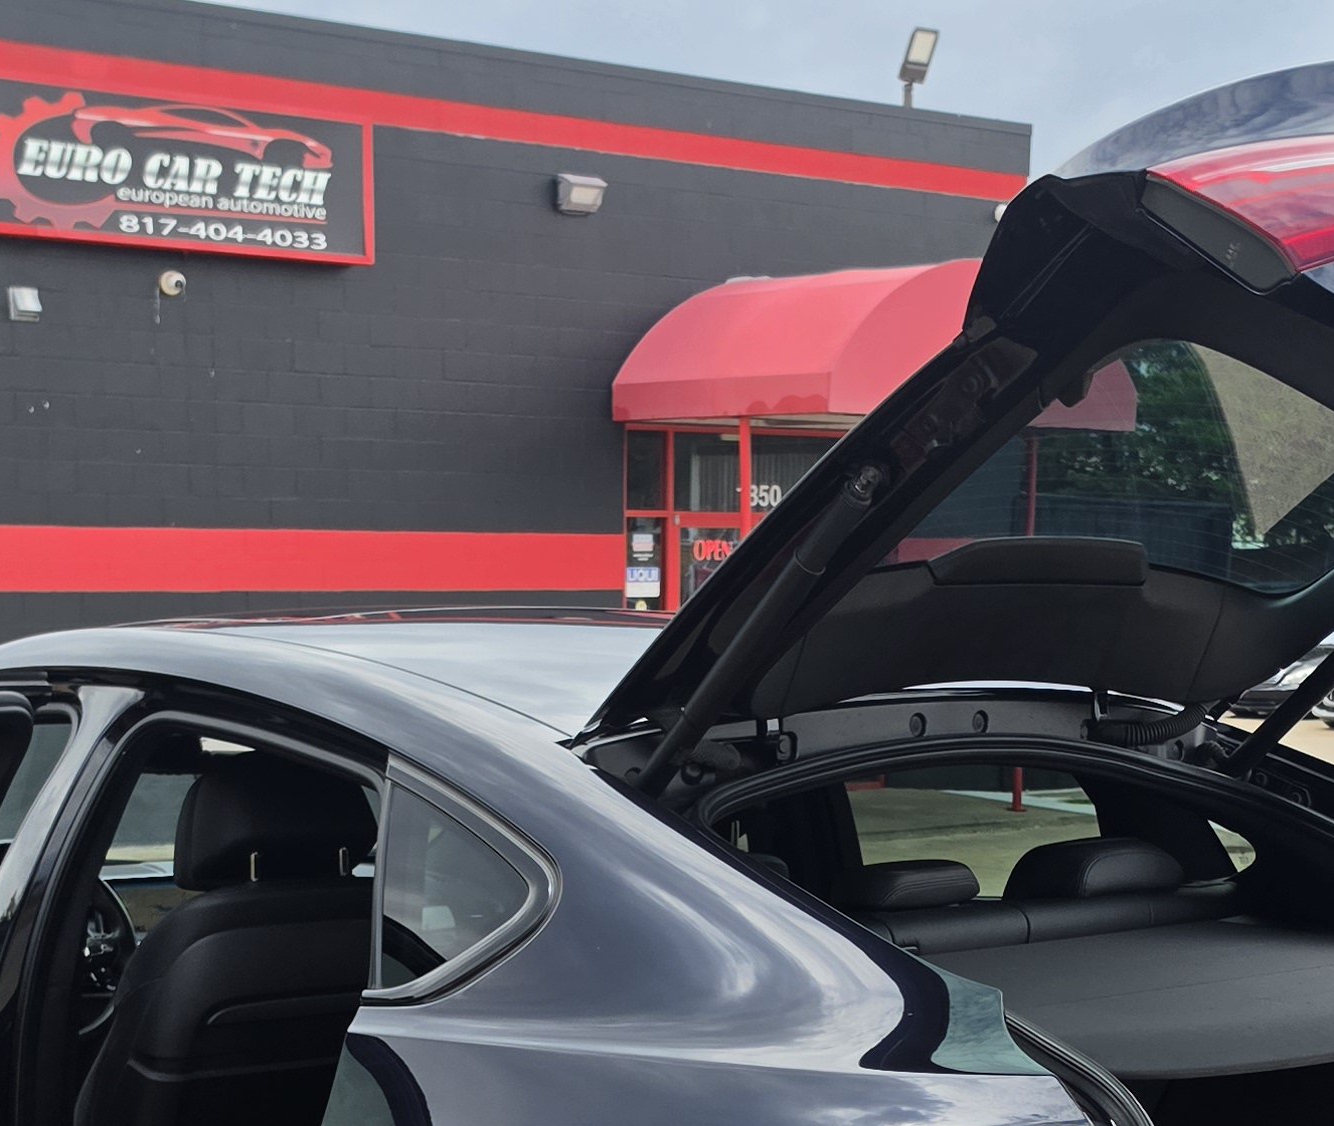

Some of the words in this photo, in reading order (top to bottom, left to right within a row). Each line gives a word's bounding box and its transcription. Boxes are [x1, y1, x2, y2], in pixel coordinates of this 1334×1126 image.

[17, 137, 133, 185] EURO
[142, 151, 224, 196] CAR
[232, 162, 332, 206] TECH
[116, 185, 214, 210] european
[216, 194, 327, 221] automotive
[119, 215, 329, 250] 817-404-4033
[693, 540, 734, 561] OPEN
